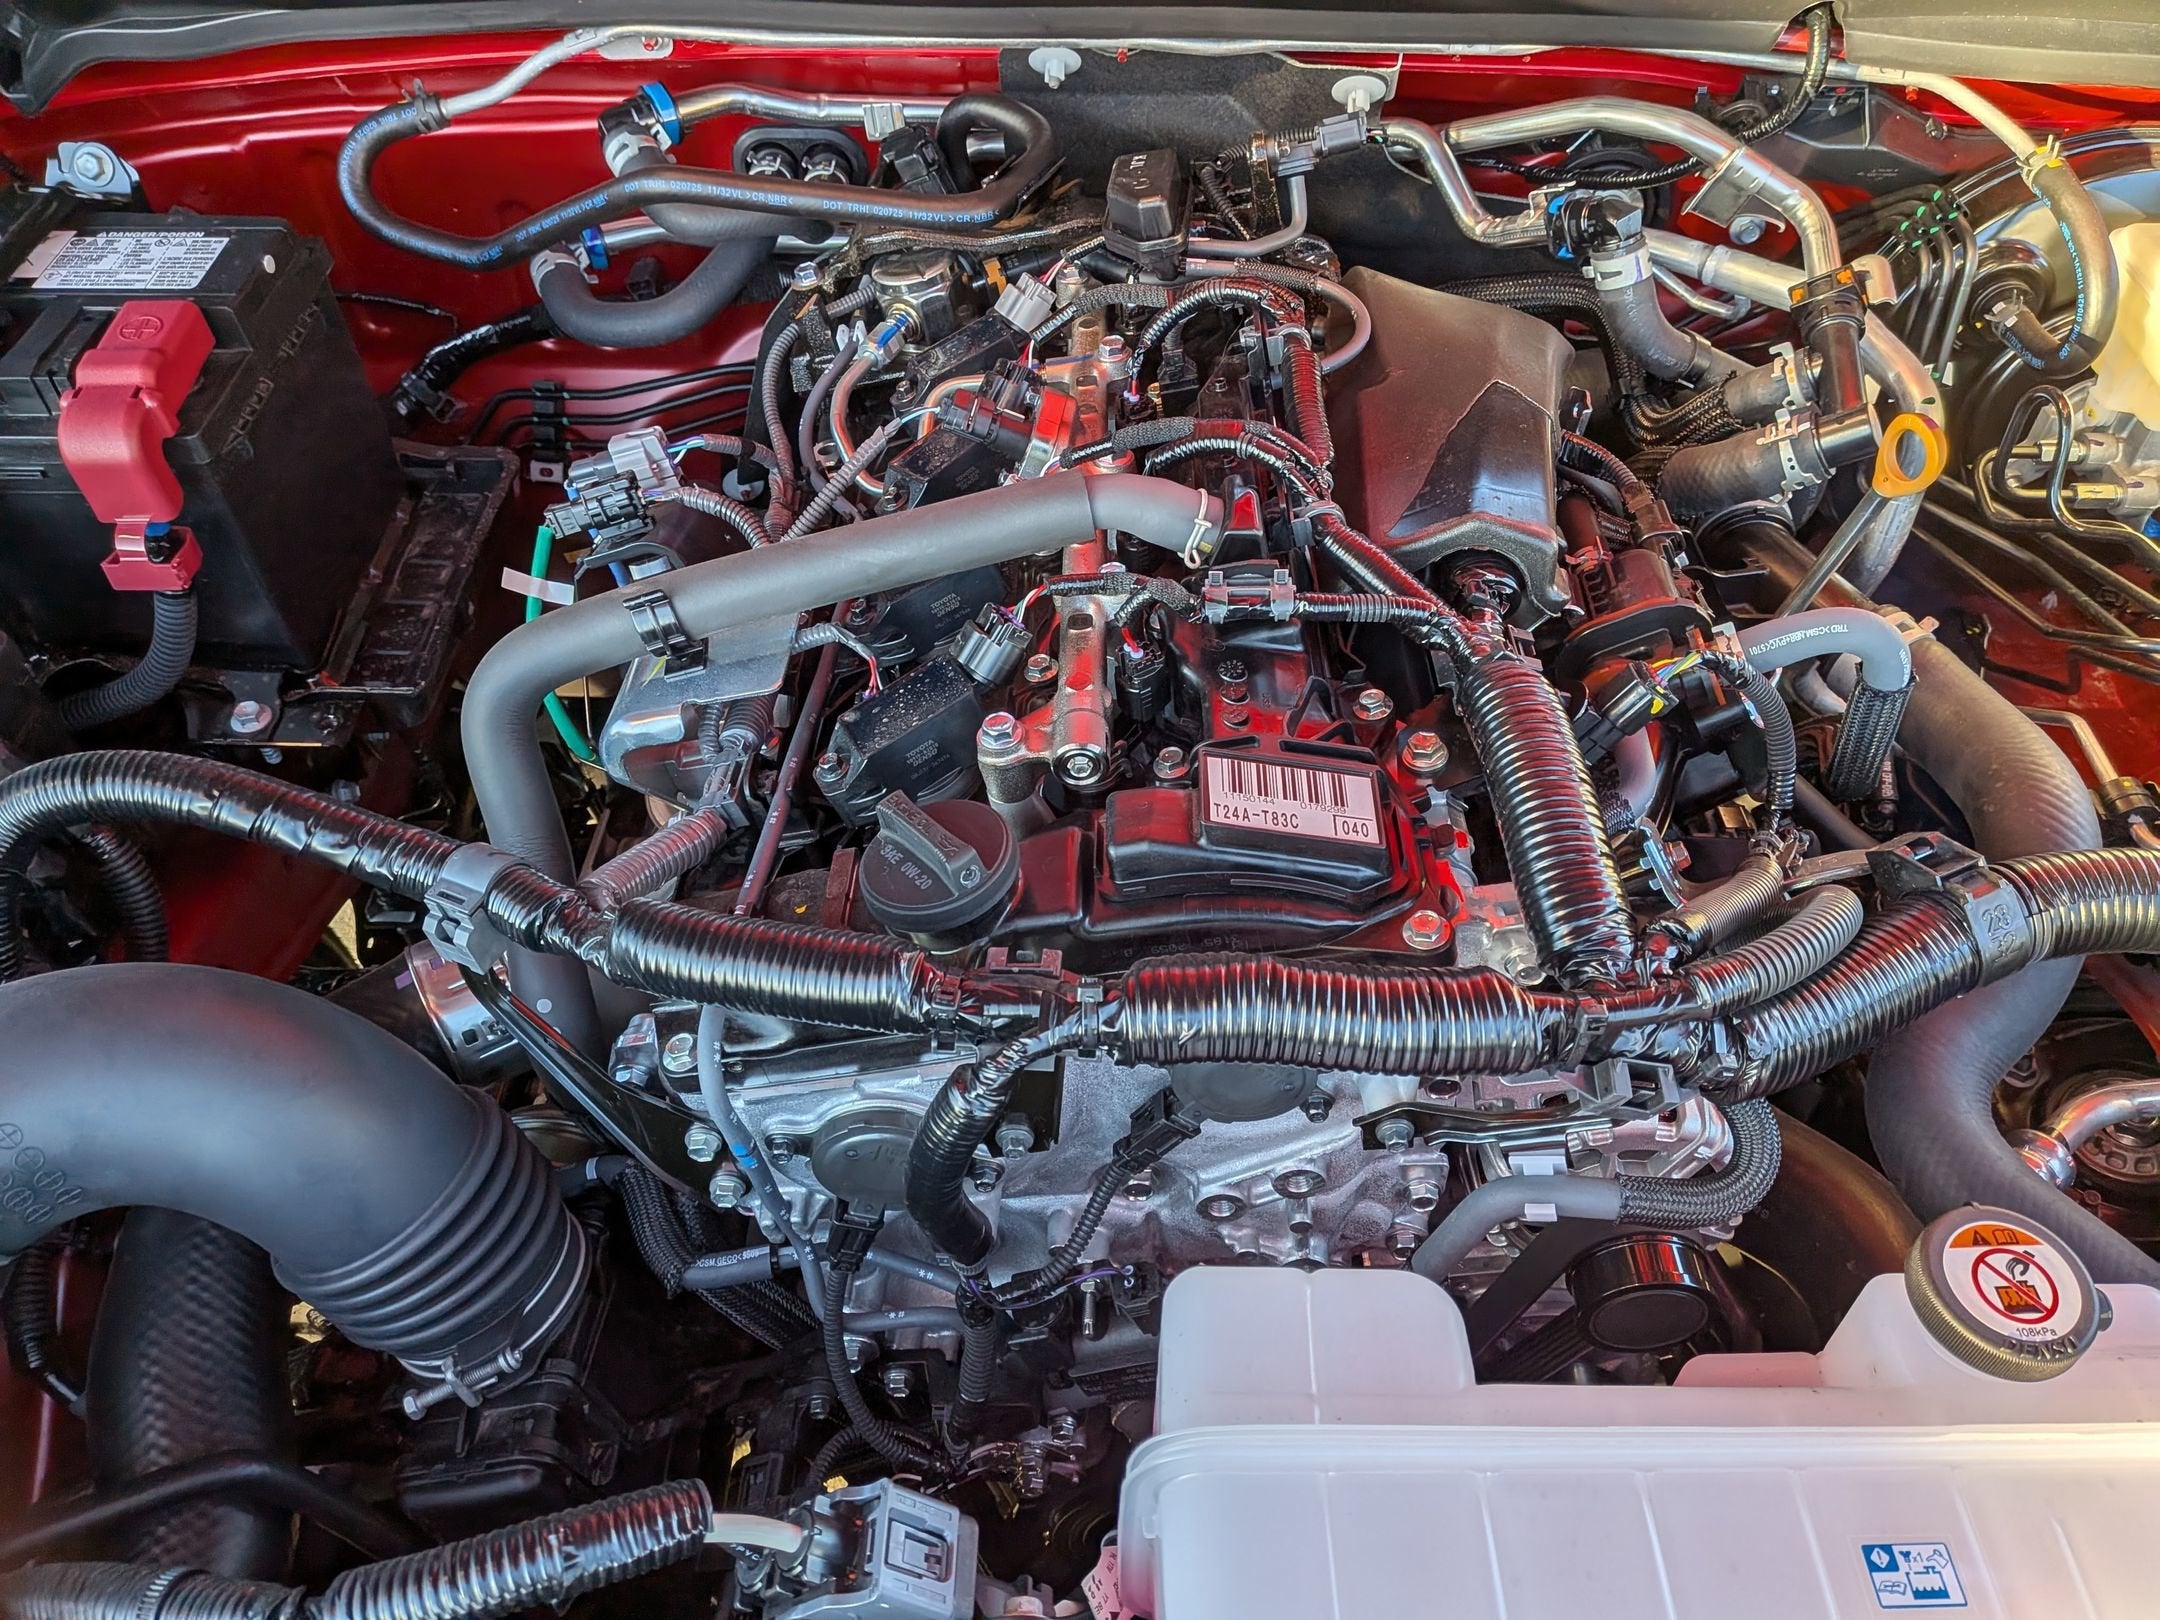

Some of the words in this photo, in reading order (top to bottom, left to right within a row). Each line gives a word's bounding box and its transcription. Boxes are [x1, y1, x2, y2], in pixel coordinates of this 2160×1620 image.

[823, 200, 843, 210] DOT
[873, 206, 904, 218] 020725
[905, 739, 935, 758] TOYOTA
[1223, 791, 1276, 806] 11150144
[1213, 802, 1299, 829] T24A-T83C
[1342, 820, 1370, 838] 040
[880, 844, 904, 865] SAE
[901, 861, 933, 890] 0W-20
[2016, 1327, 2058, 1338] 108kPa
[2000, 1336, 2079, 1361] DENSO
